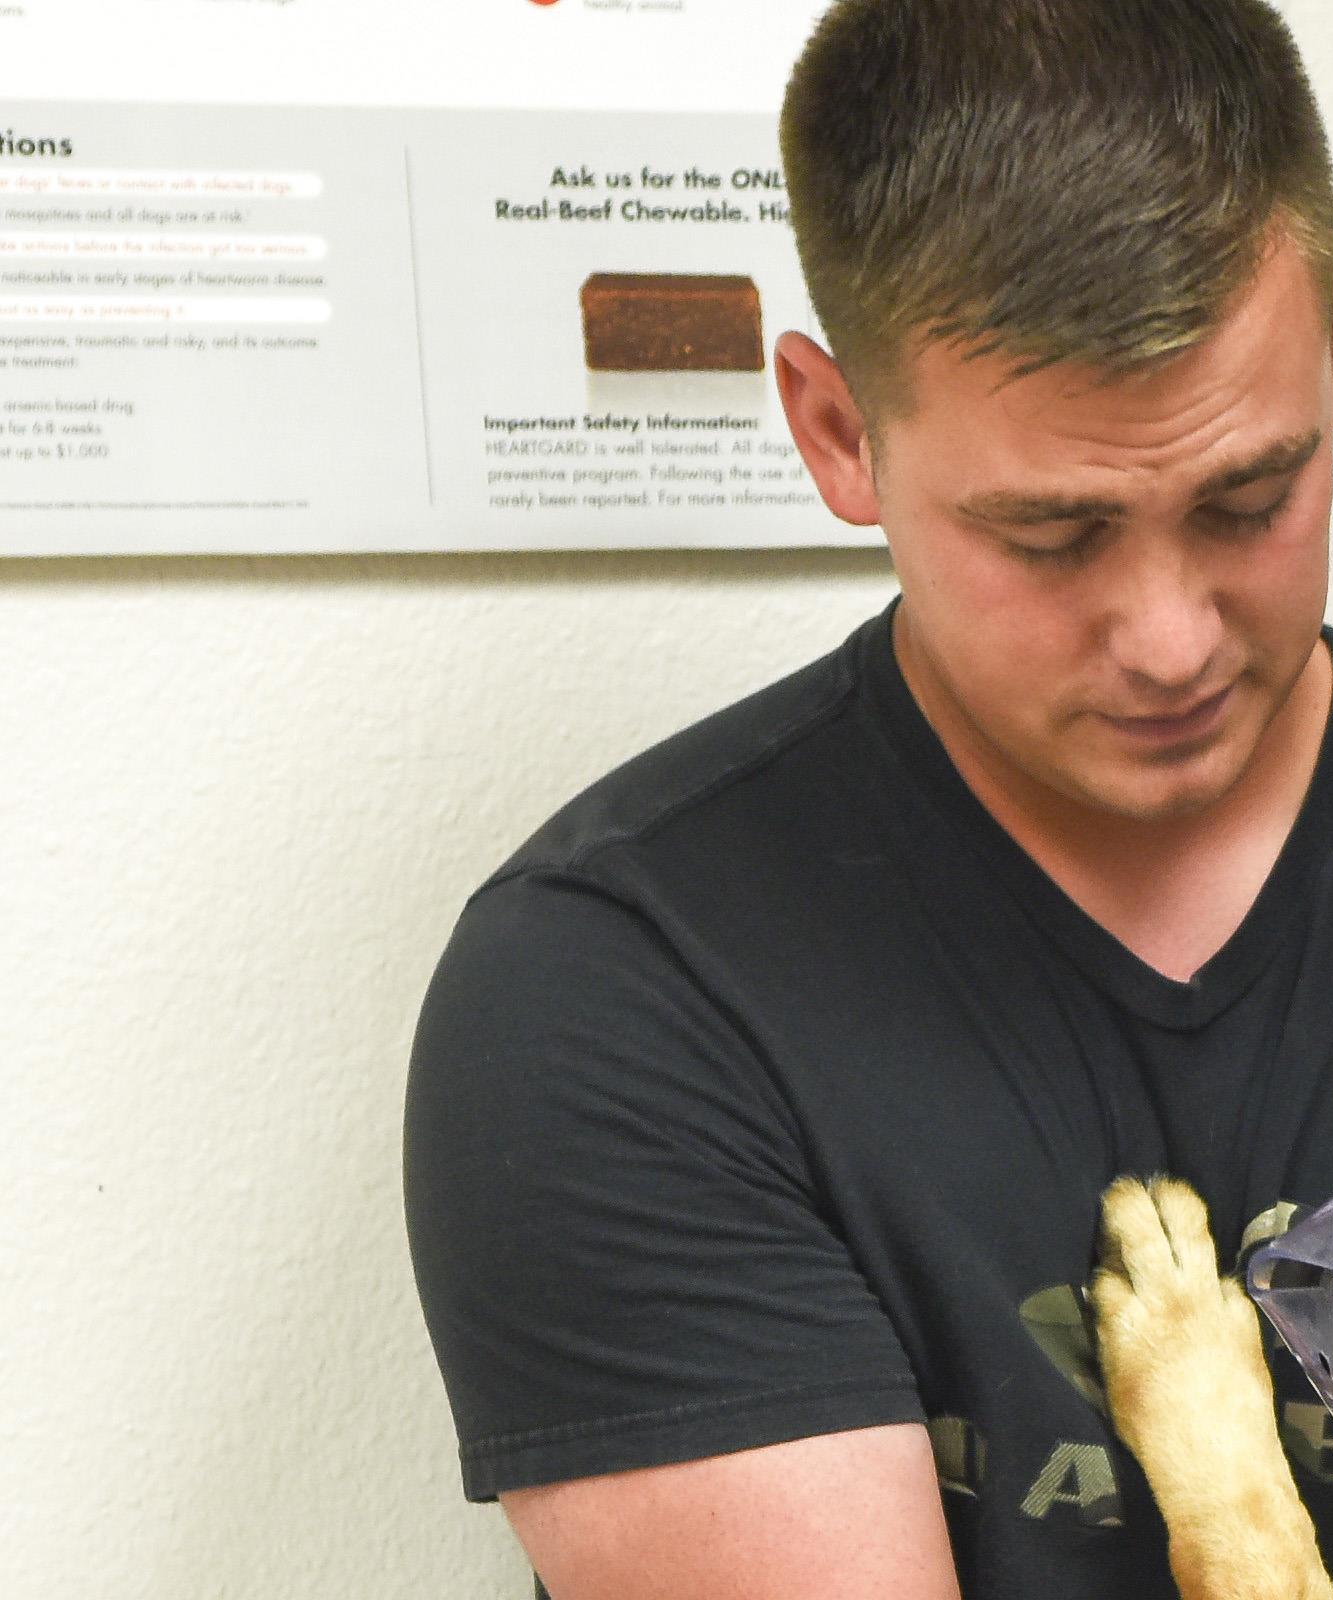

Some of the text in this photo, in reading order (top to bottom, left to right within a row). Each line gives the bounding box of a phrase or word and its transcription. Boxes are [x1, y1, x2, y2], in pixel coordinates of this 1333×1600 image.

[550, 166, 786, 190] Ask us for the ONL
[621, 199, 750, 222] Chewable.
[484, 414, 576, 435] Important
[582, 411, 640, 434] Safety
